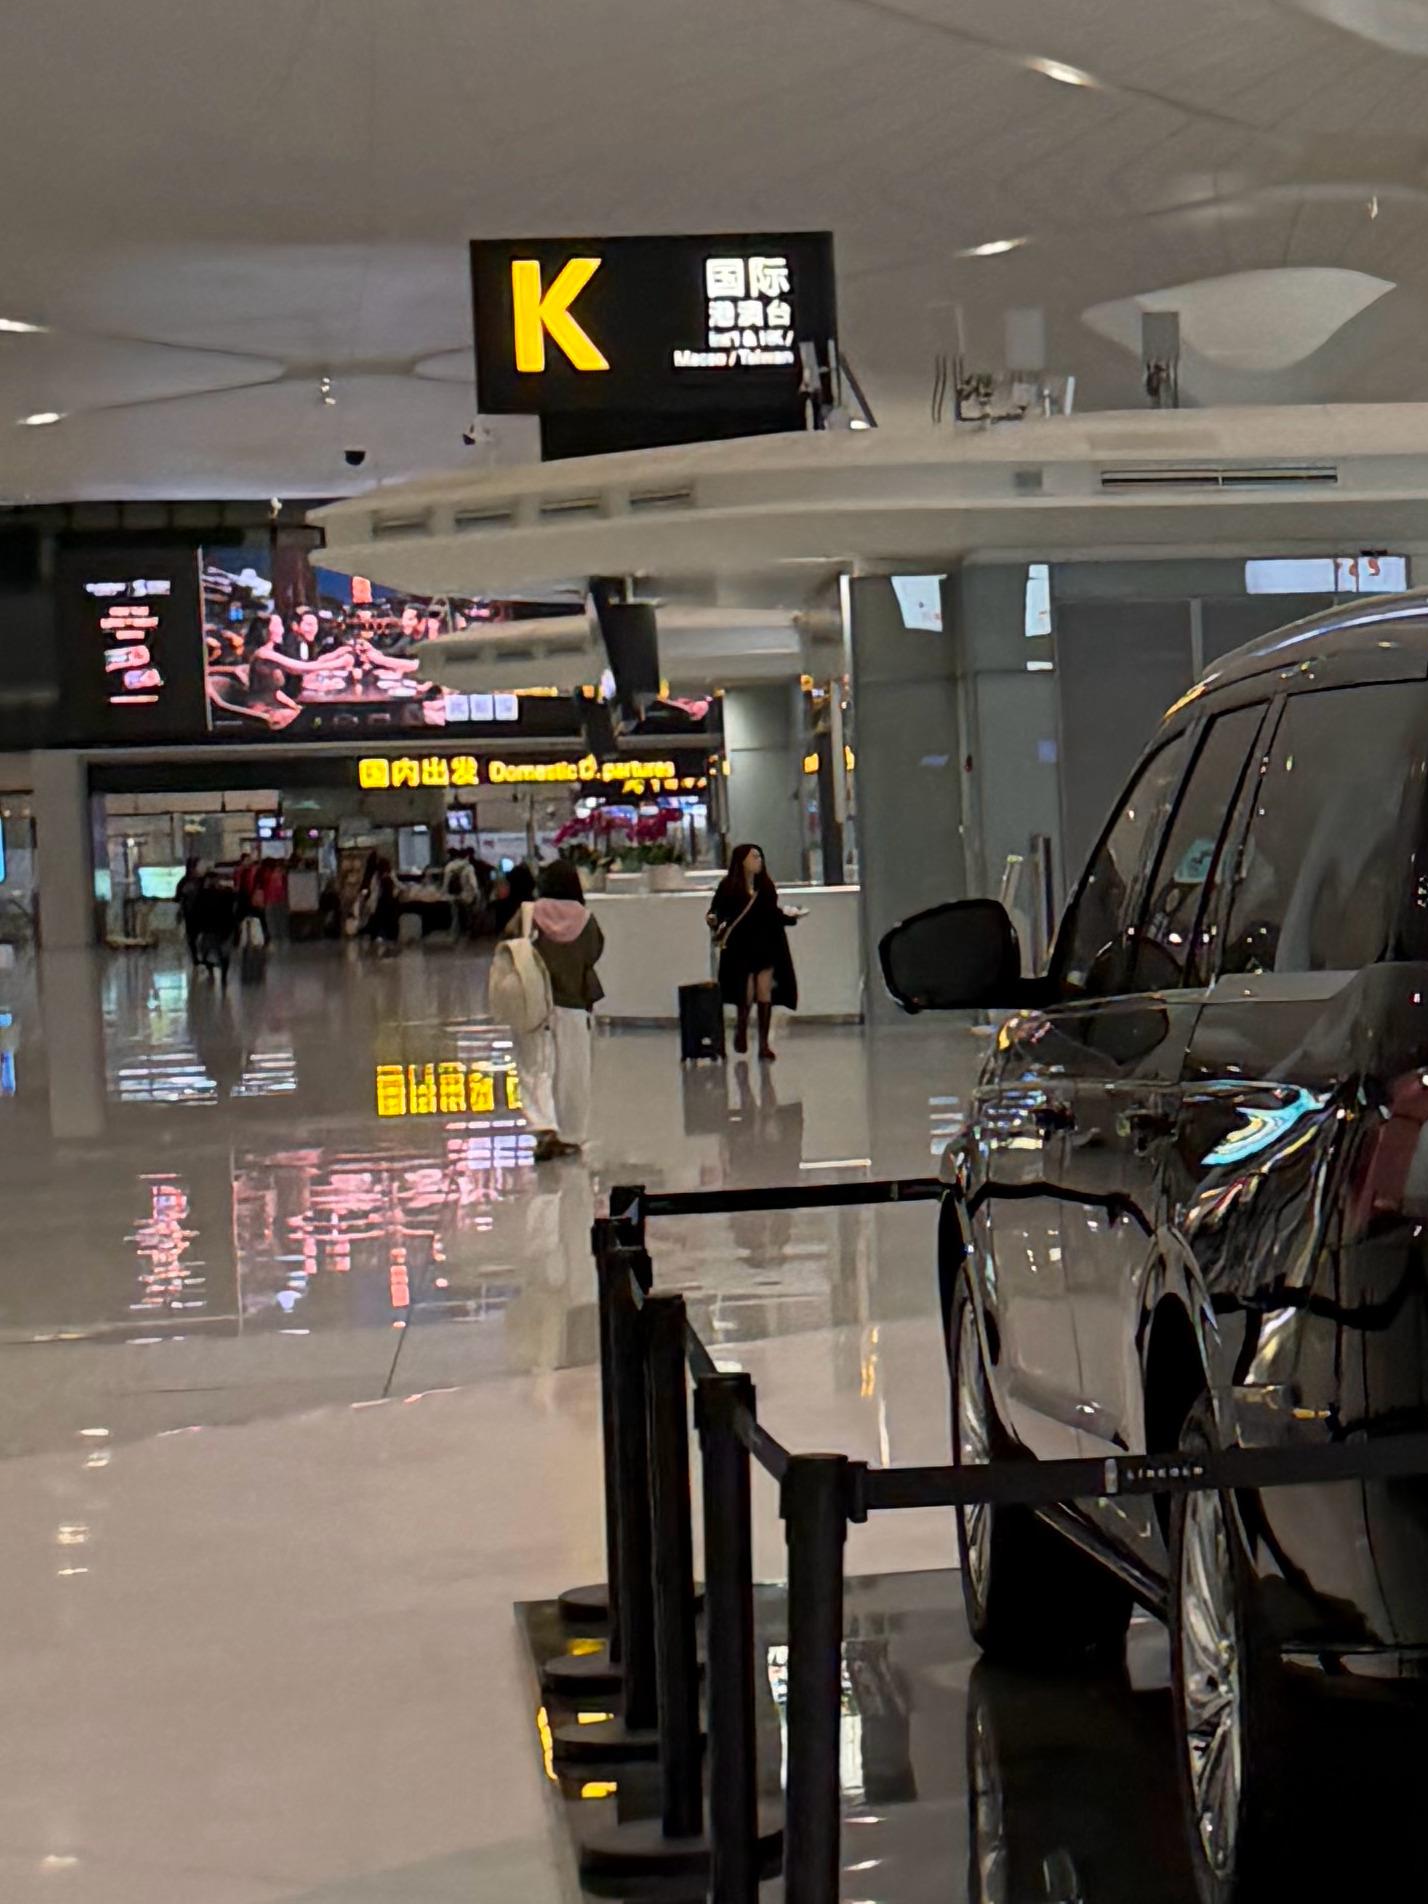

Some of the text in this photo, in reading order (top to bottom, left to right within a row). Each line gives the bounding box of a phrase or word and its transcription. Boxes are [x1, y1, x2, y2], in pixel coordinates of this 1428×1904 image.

[705, 256, 791, 298] 国际
[511, 257, 610, 373] K
[358, 755, 479, 789] 国内出发
[578, 753, 676, 783] Dpartures
